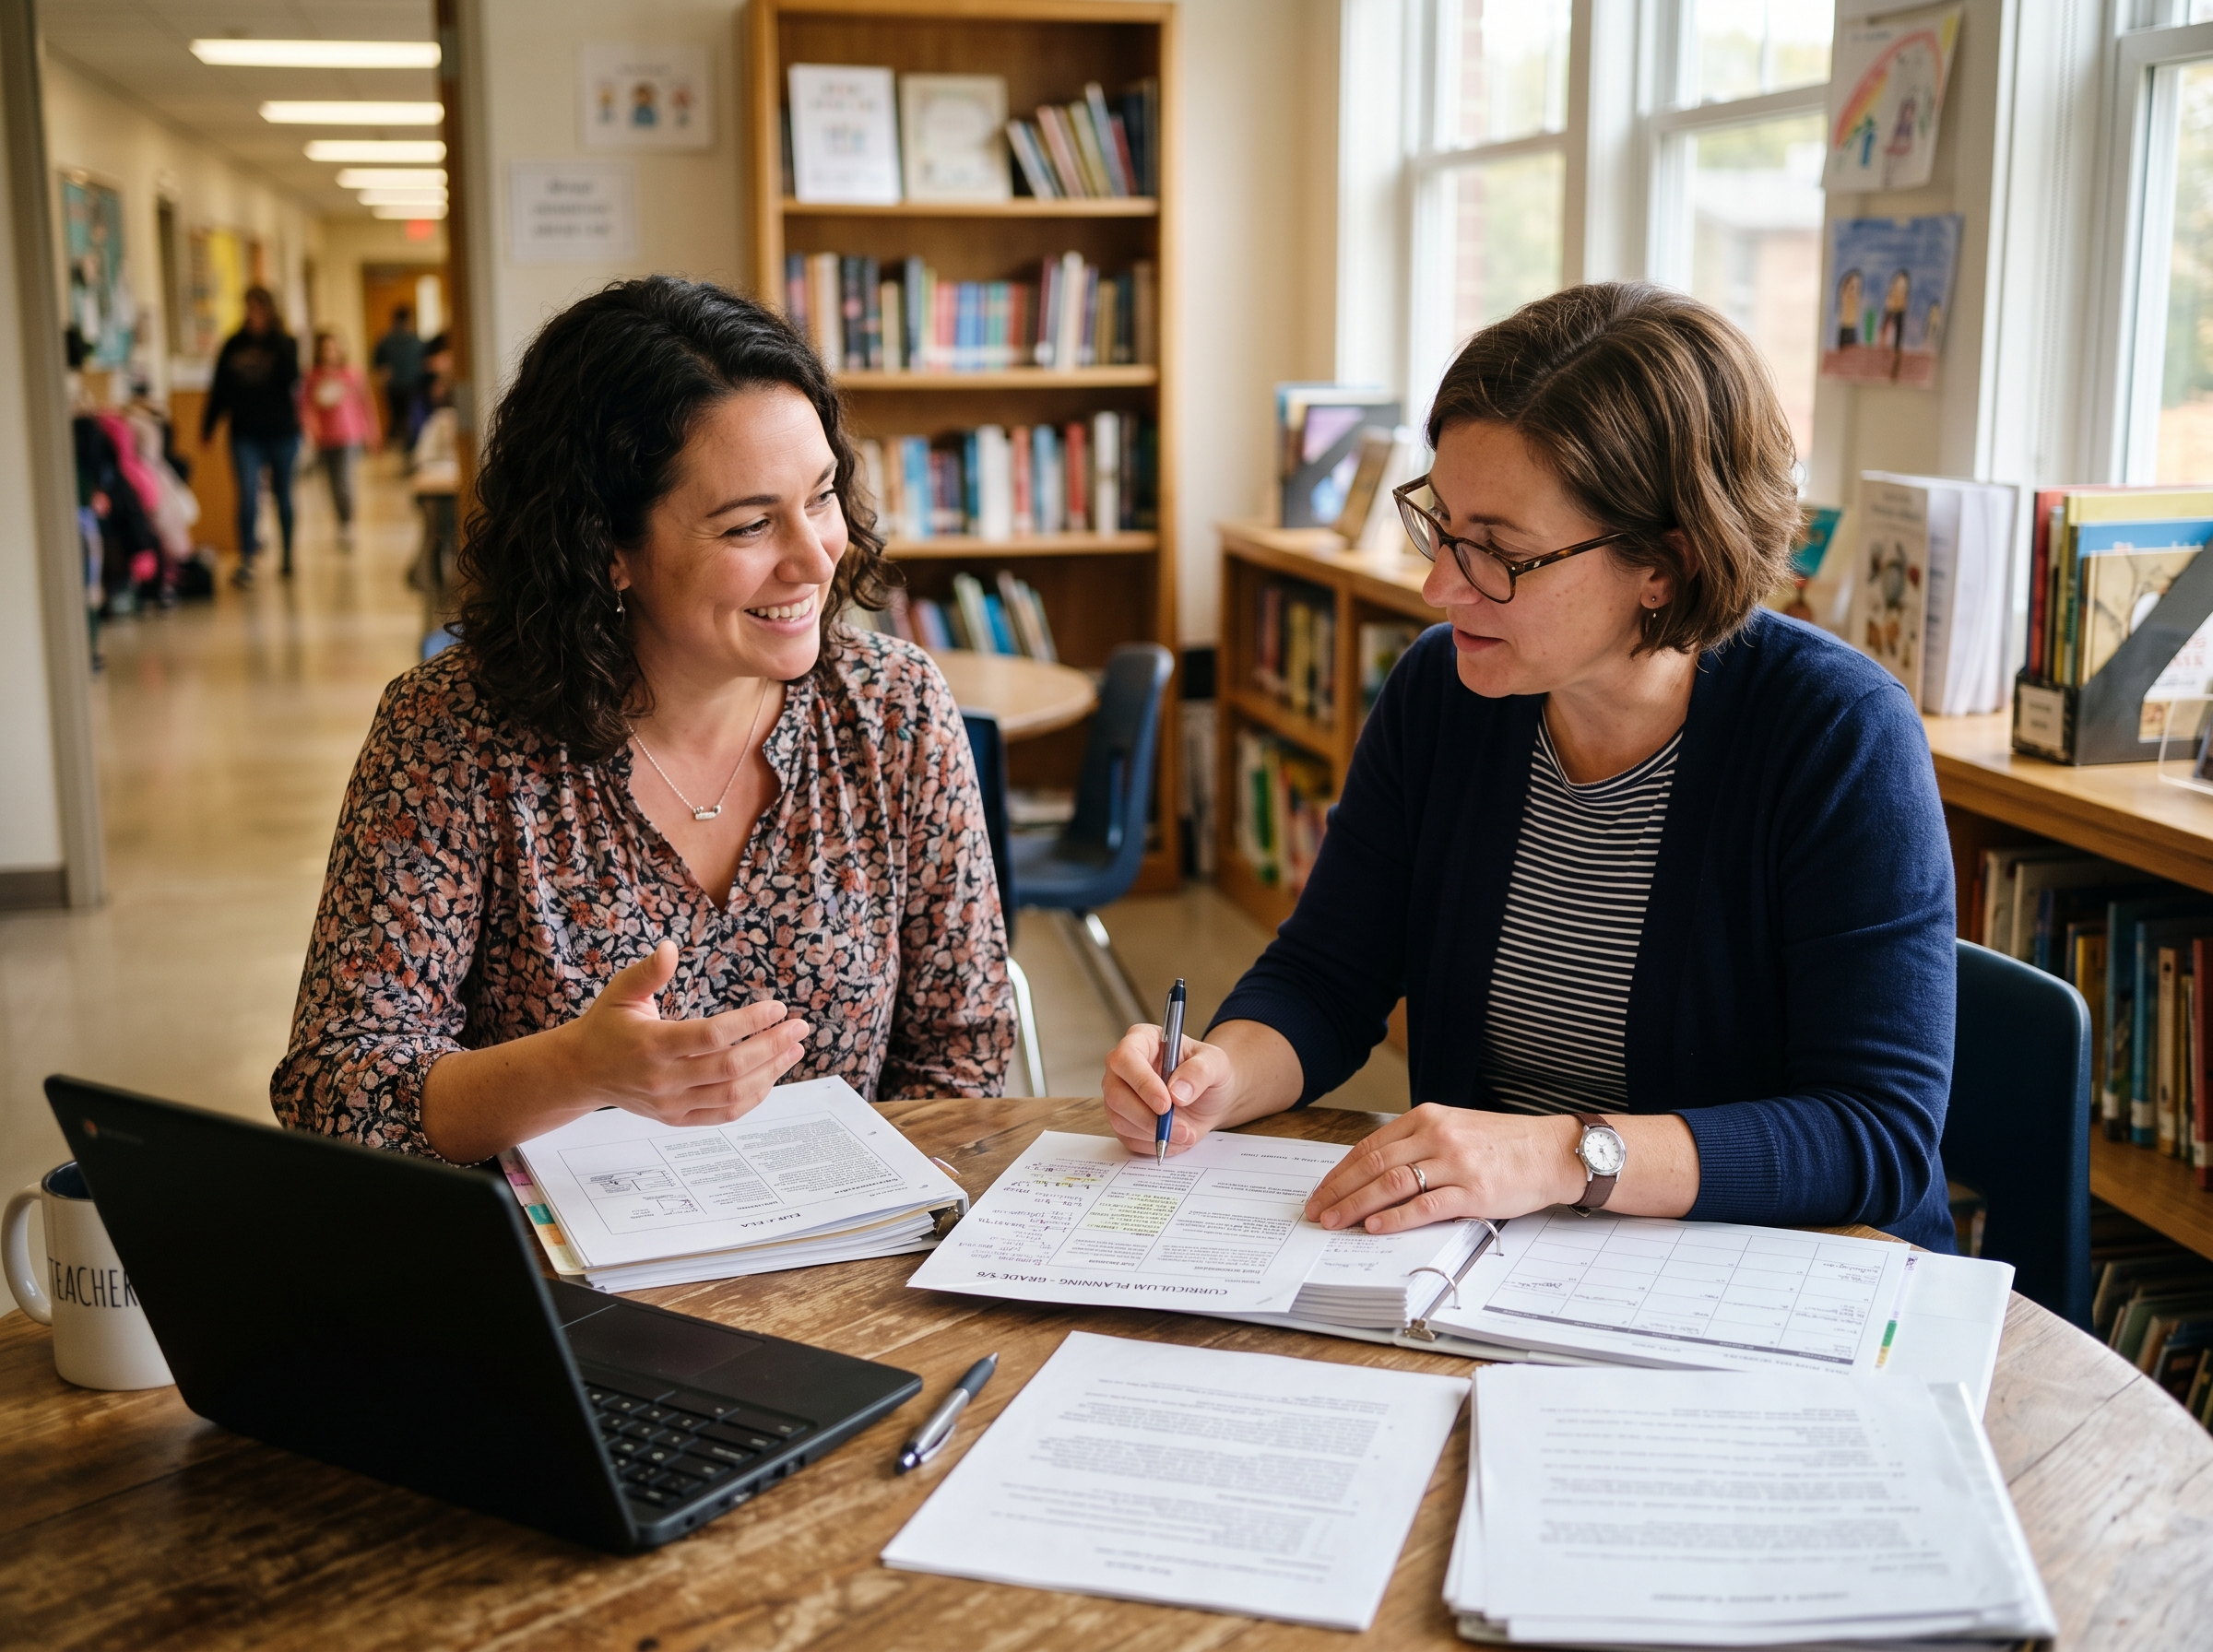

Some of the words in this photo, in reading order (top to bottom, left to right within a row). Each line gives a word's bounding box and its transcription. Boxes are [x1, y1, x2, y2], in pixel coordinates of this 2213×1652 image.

[48, 1257, 139, 1308] TEACHER
[1000, 1273, 1047, 1283] GRADE
[1059, 1279, 1130, 1290] PLANNING
[1134, 1284, 1227, 1295] CURRICULUM
